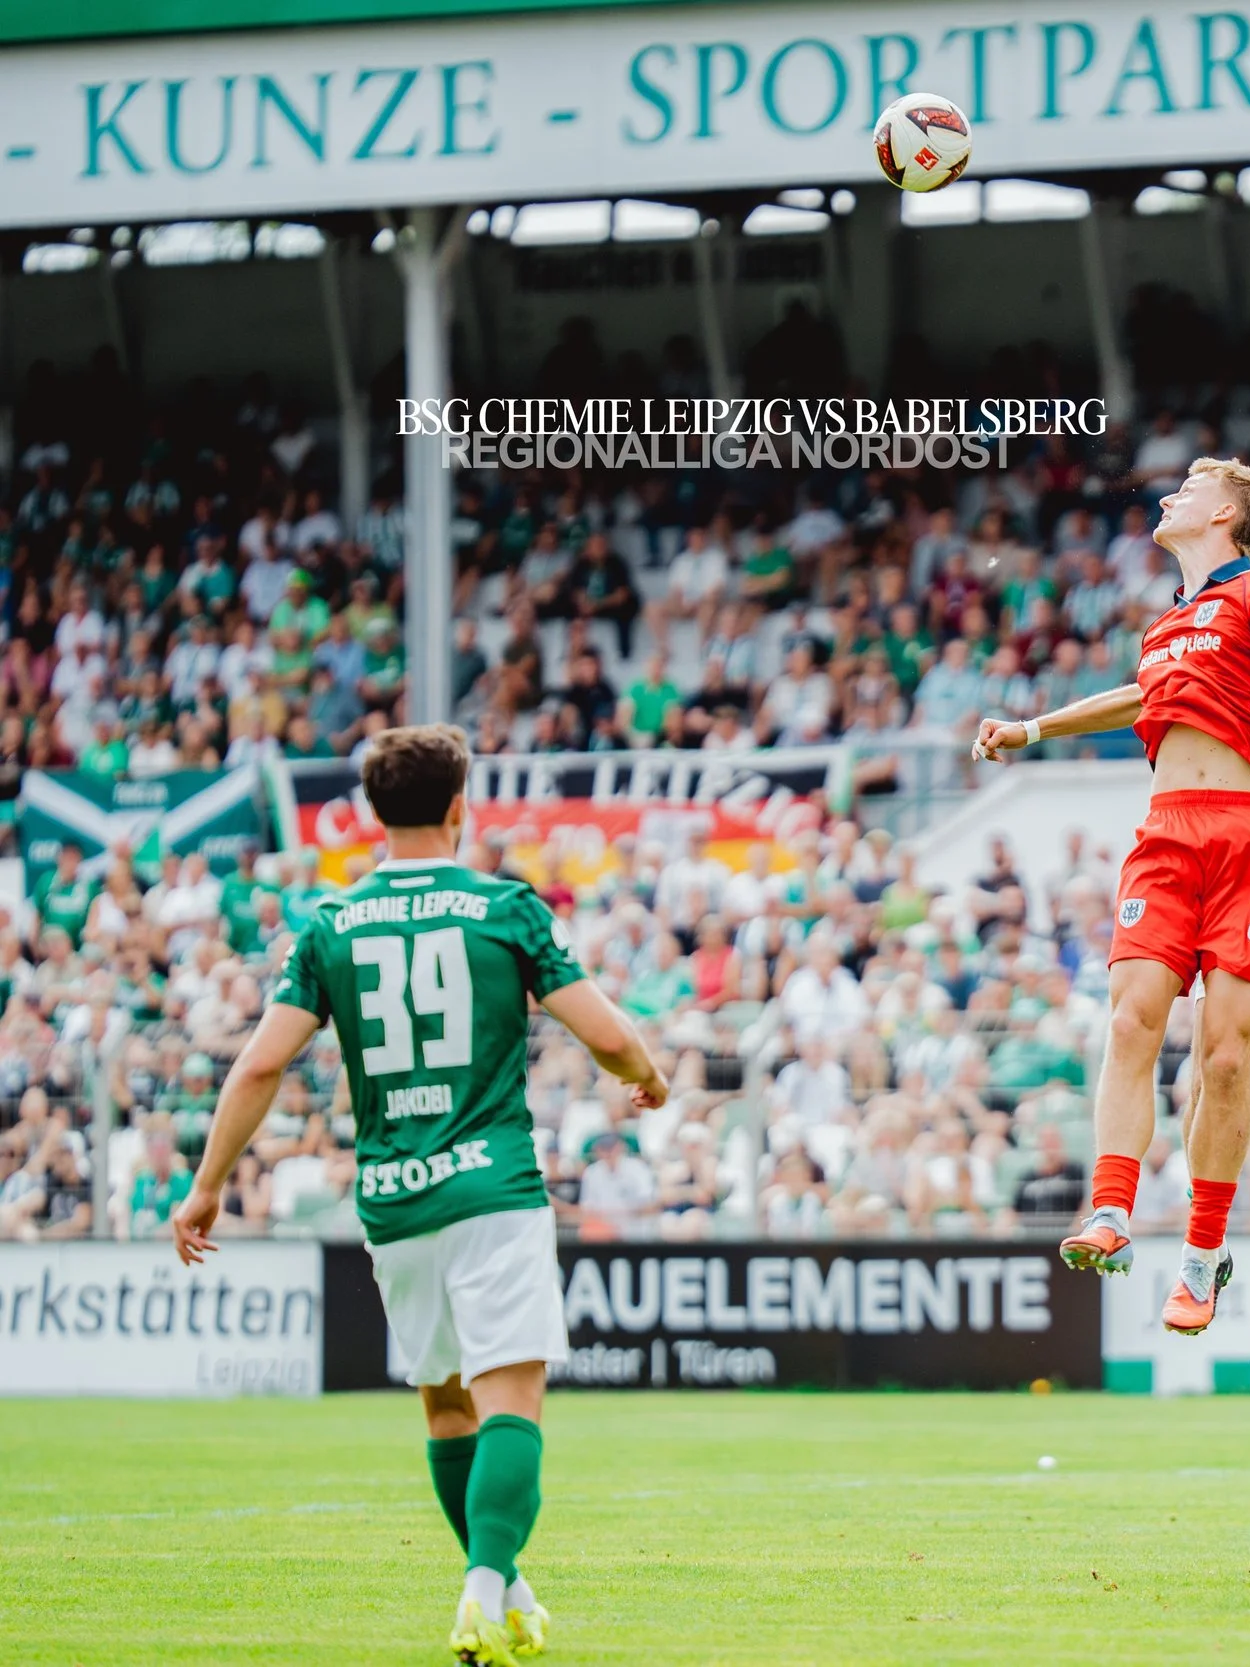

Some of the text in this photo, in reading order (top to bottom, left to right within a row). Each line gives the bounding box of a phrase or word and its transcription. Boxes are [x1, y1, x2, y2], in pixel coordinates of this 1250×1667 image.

[78, 60, 501, 178] KUNZE
[1187, 632, 1222, 653] Liebe
[334, 890, 490, 935] CHEMIE LEIPZIG
[351, 926, 473, 1077] 39
[385, 1084, 453, 1120] JAKOBI
[361, 1139, 494, 1198] STORK
[0, 1264, 317, 1338] rkstätten
[558, 1256, 1053, 1333] AUELEMENTE
